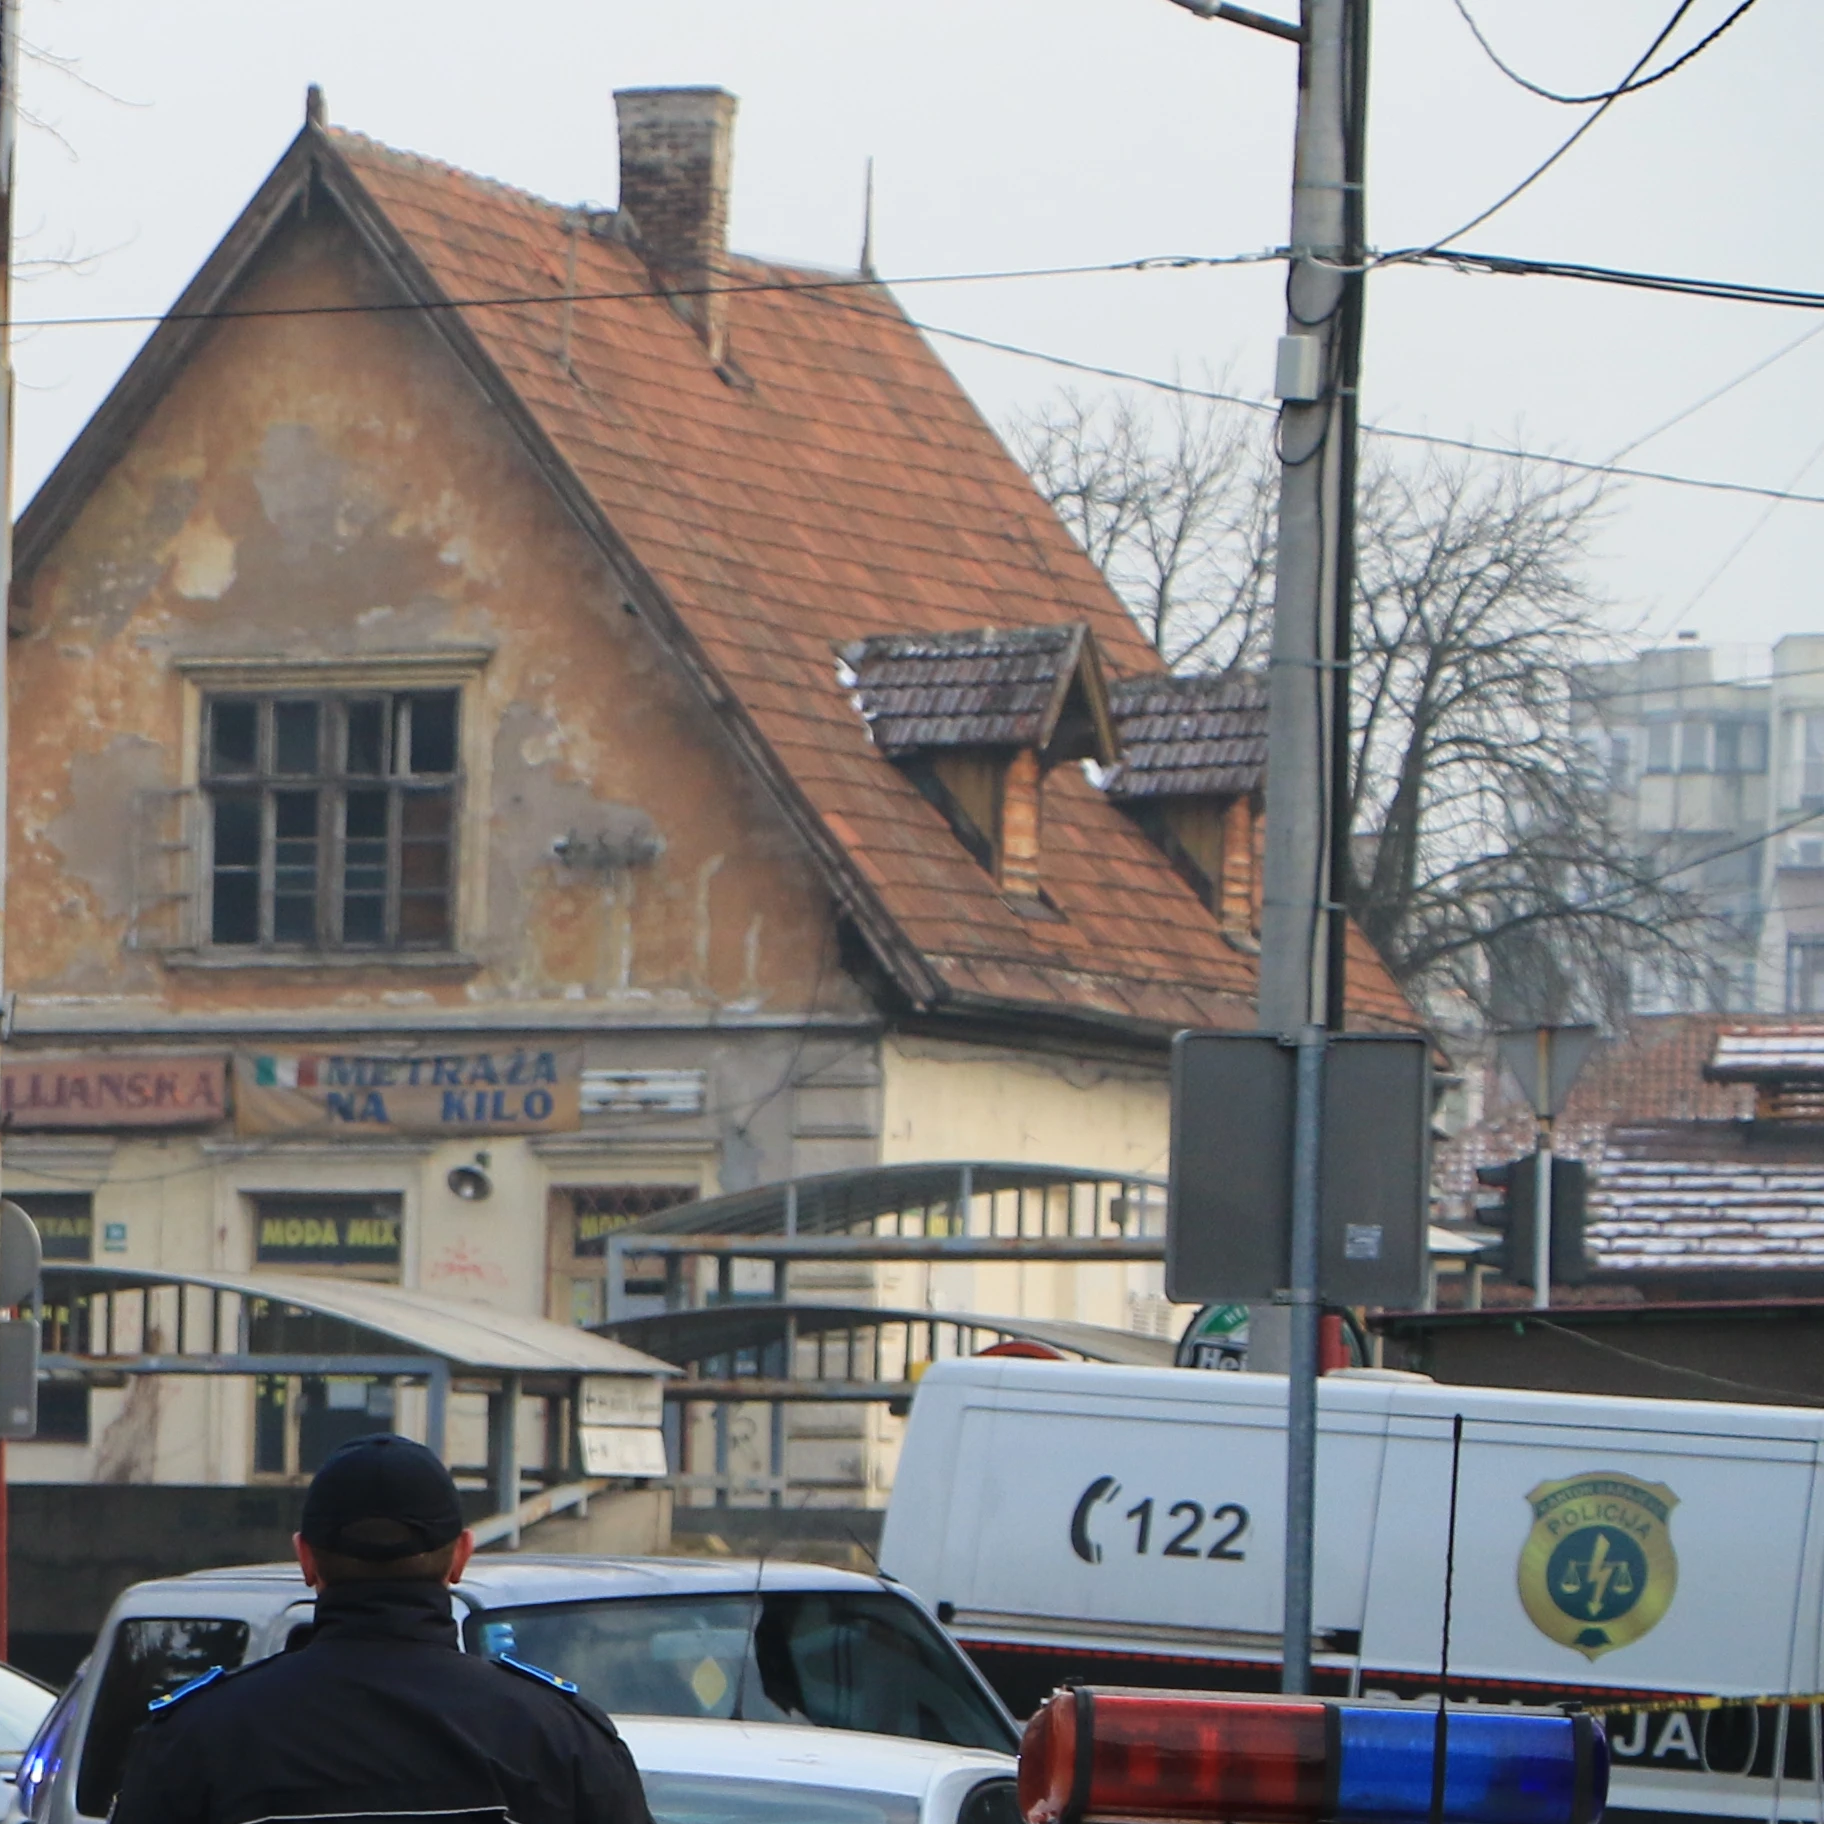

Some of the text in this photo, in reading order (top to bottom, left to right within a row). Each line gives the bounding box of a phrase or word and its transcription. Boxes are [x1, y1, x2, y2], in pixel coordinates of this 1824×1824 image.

[327, 1088, 554, 1123] NA KILO
[261, 1217, 398, 1246] MODA MIX
[1127, 1497, 1251, 1560] 122
[1547, 1503, 1653, 1540] POLICIJA
